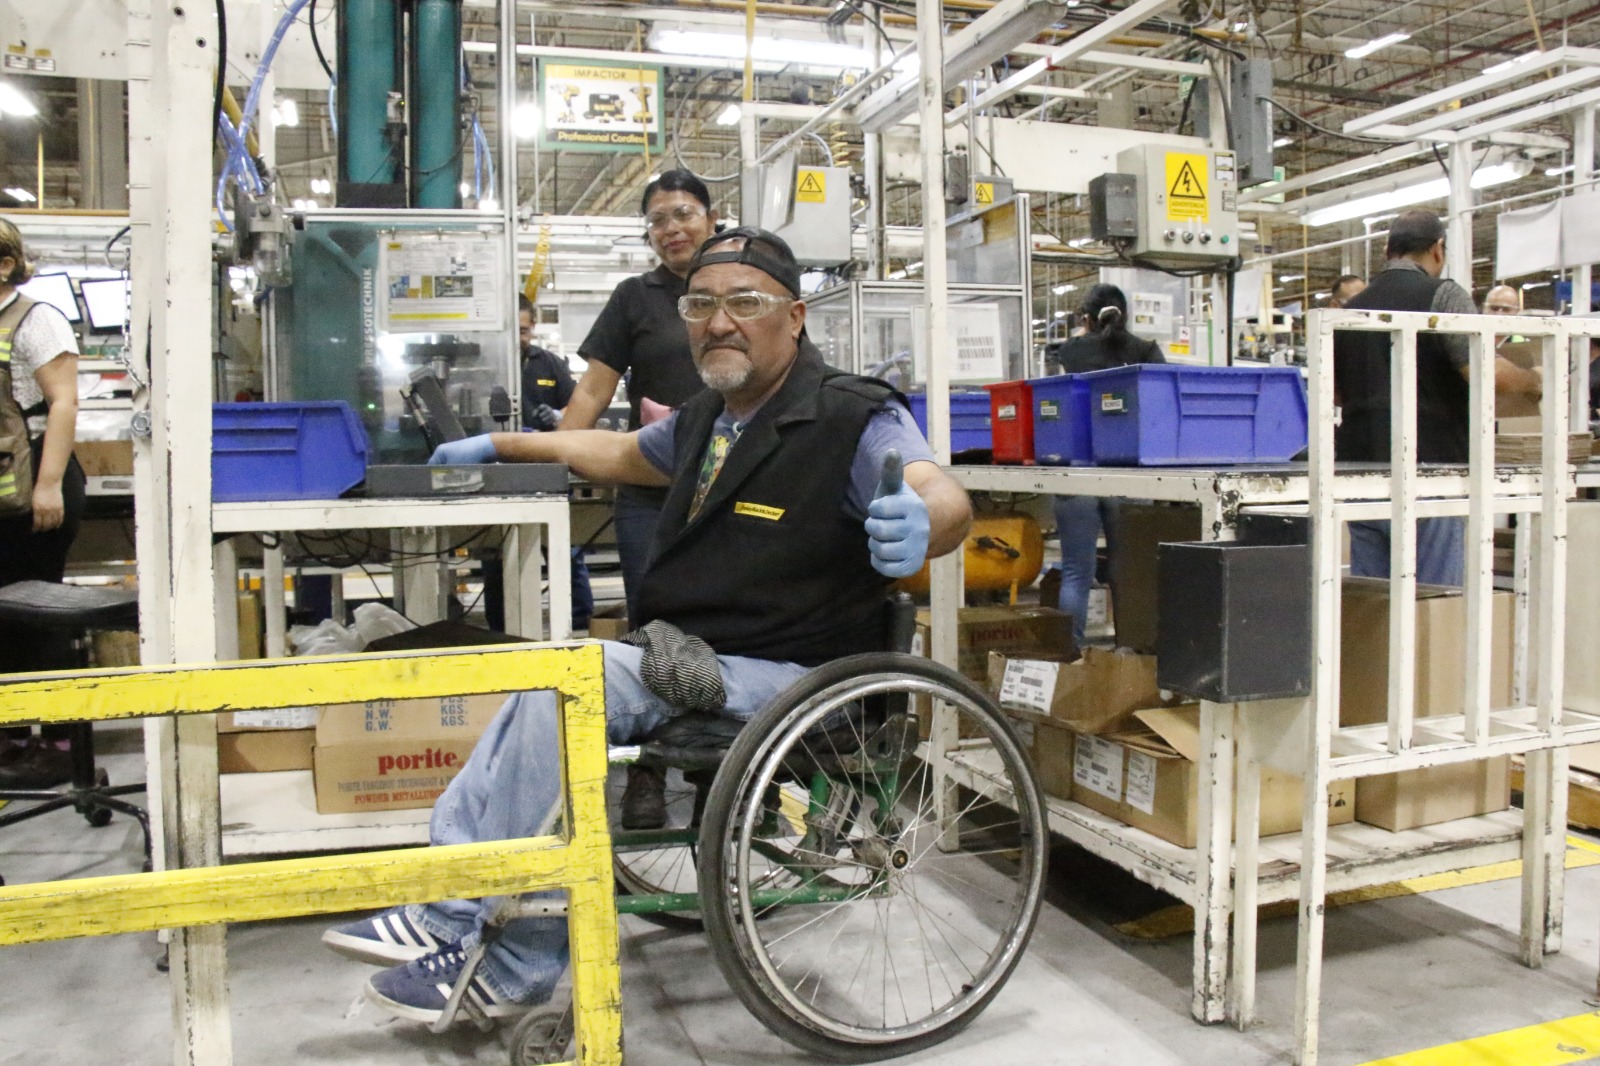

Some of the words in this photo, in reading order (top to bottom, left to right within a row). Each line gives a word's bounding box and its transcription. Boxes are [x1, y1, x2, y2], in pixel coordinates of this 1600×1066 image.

[574, 69, 626, 79] IMPACTOR
[365, 709, 393, 720] N.W.
[440, 704, 468, 715] KGS.
[365, 720, 392, 732] G.W.
[441, 715, 469, 727] KGS.
